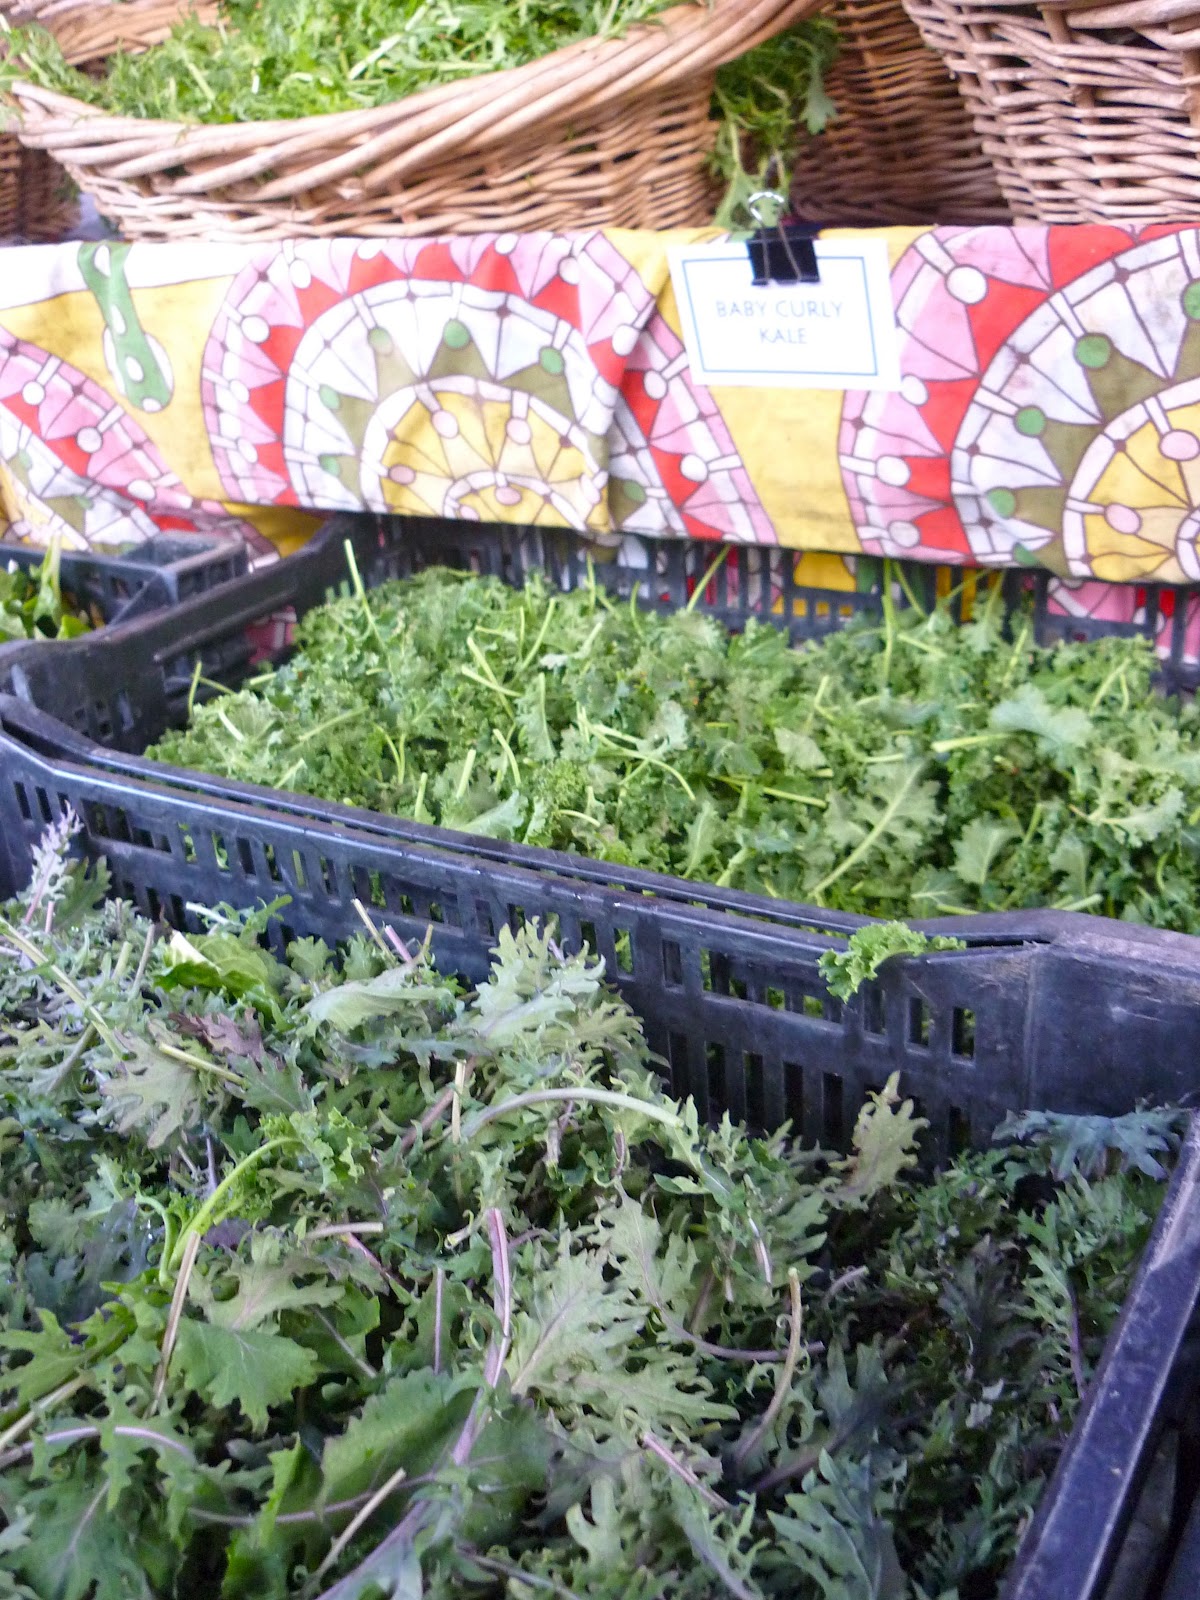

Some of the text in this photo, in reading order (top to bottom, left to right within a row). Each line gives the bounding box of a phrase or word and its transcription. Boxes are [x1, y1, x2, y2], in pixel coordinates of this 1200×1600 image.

[715, 299, 844, 318] BABY CURLY
[759, 327, 808, 345] KALE
